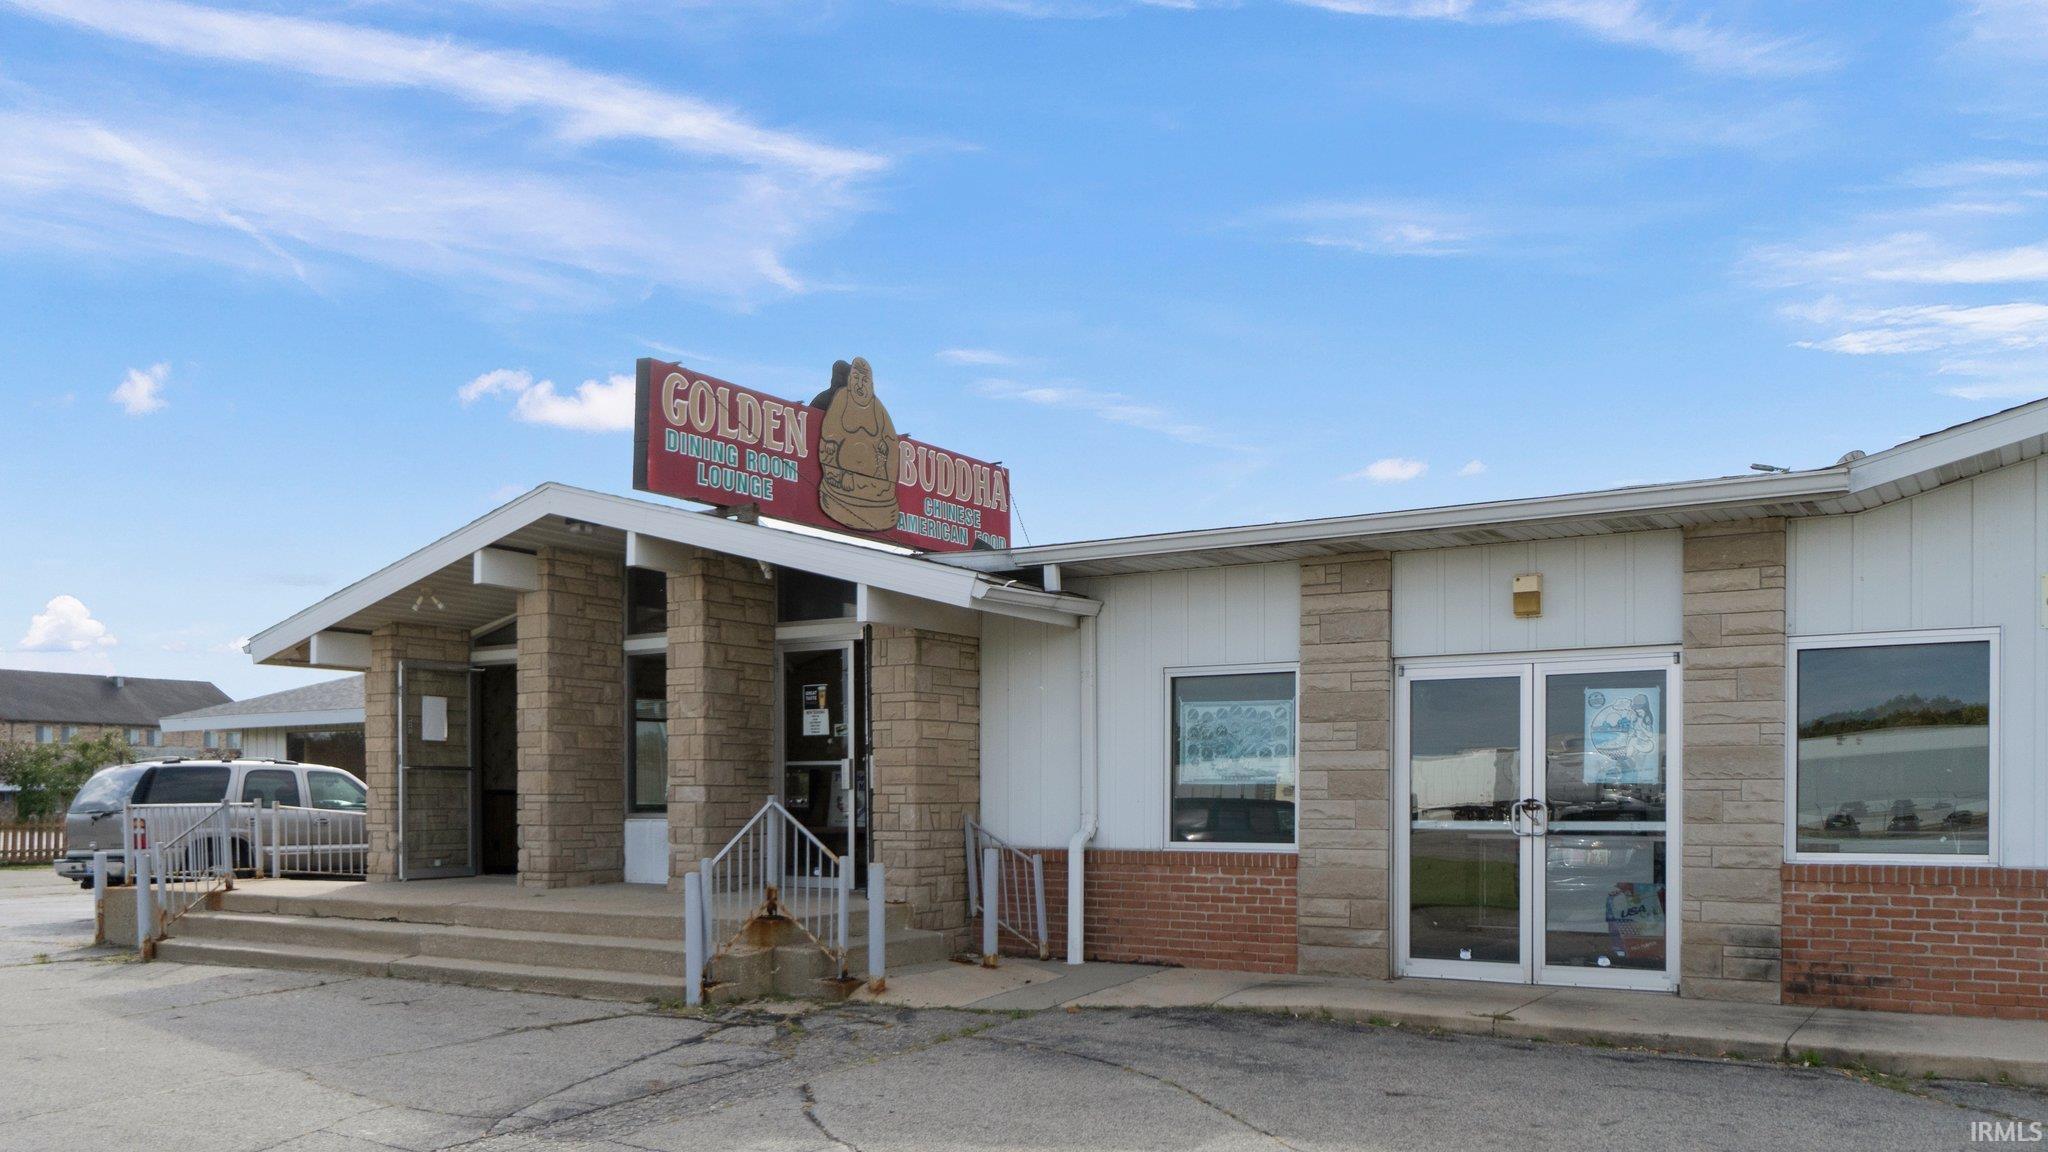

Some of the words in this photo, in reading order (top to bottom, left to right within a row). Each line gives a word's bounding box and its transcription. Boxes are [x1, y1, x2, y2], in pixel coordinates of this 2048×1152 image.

[662, 372, 808, 458] GOLDEN
[665, 428, 739, 467] DINING
[746, 449, 798, 483] ROOM
[898, 441, 1008, 512] BUDDHA
[697, 462, 773, 501] LOUNGE
[897, 512, 968, 546] AMERICAN
[924, 497, 981, 529] CHINESE
